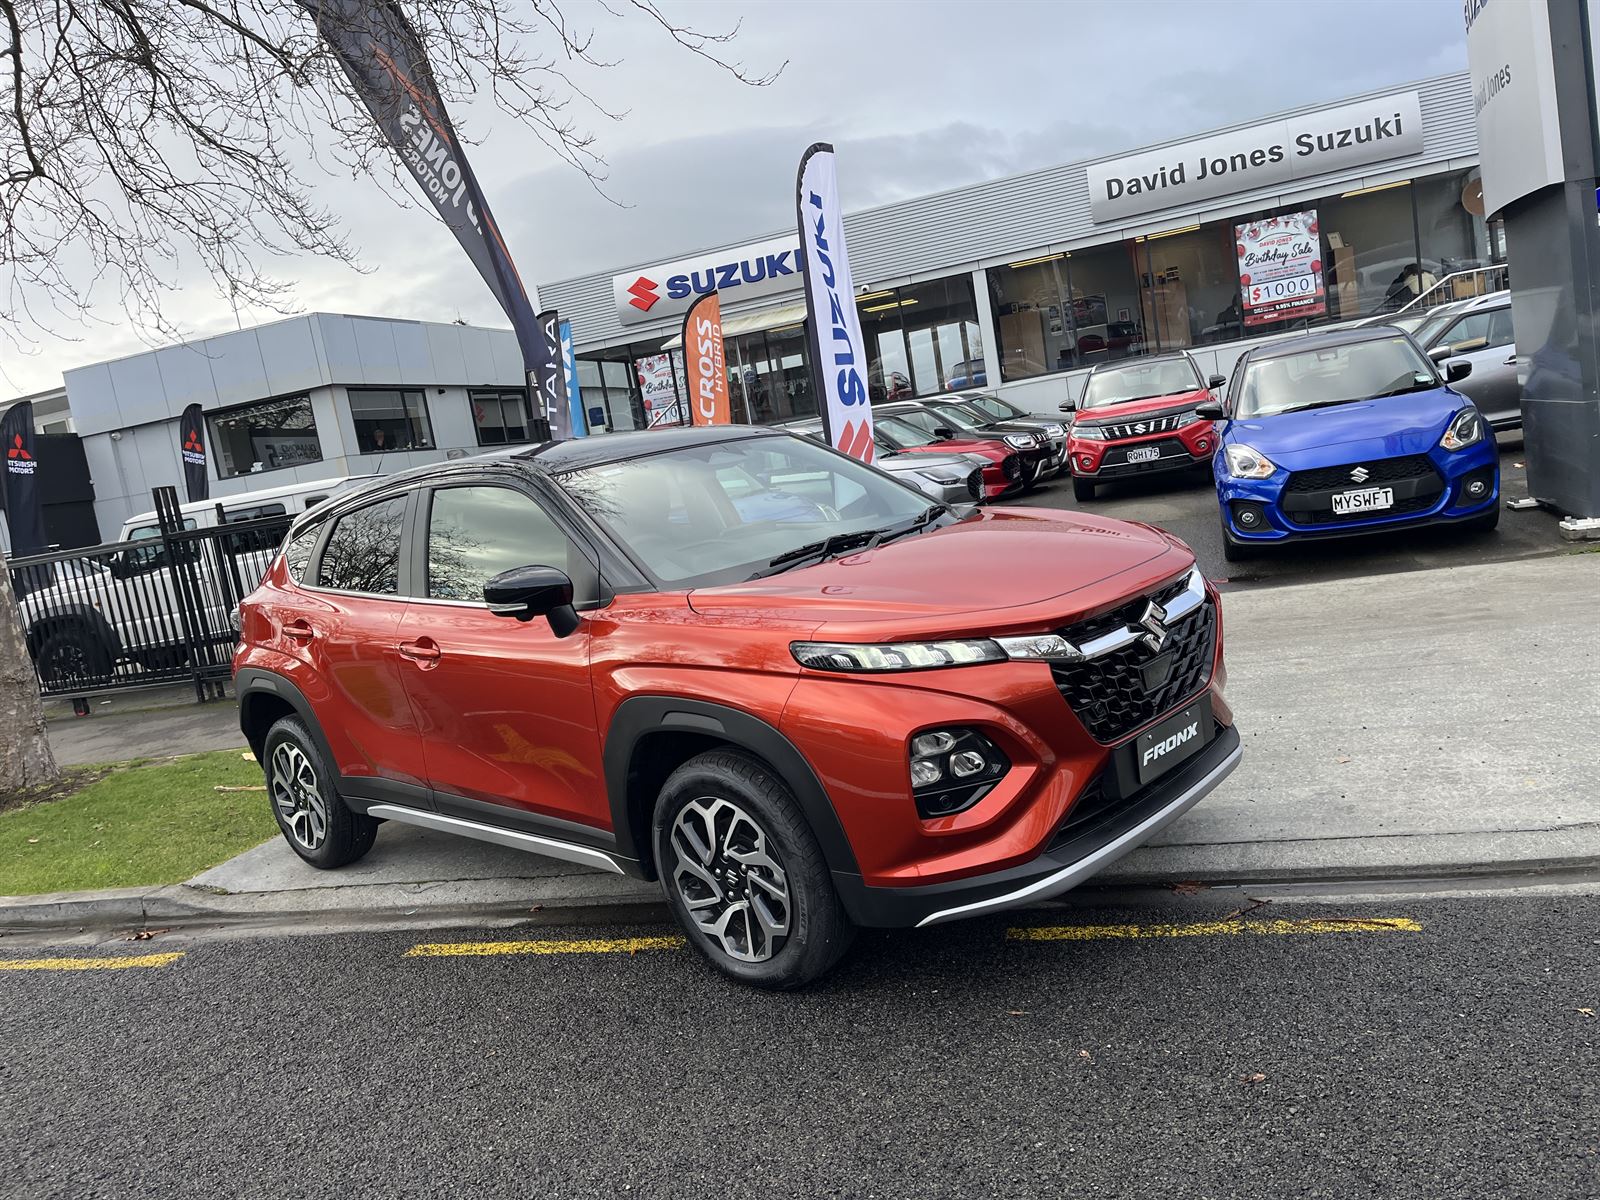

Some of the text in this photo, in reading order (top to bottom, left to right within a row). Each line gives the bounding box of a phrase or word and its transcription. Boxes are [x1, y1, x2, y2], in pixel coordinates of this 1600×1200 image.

[1486, 64, 1511, 102] Jones
[1105, 112, 1404, 200] David Jones Suzuki
[1244, 241, 1313, 266] Birthday Sale
[666, 248, 804, 300] SUZUKI
[809, 190, 866, 406] SUZUKI
[1252, 278, 1309, 302] $1000
[1291, 298, 1315, 307] FINANCE
[696, 316, 715, 426] -CROSS
[713, 323, 724, 393] HYBRID
[7, 460, 38, 468] ITSUBISHI
[9, 466, 35, 474] MOTORS
[184, 456, 205, 465] MOTORS
[1334, 490, 1391, 510] MYSWFT
[1143, 721, 1199, 767] FRONX
